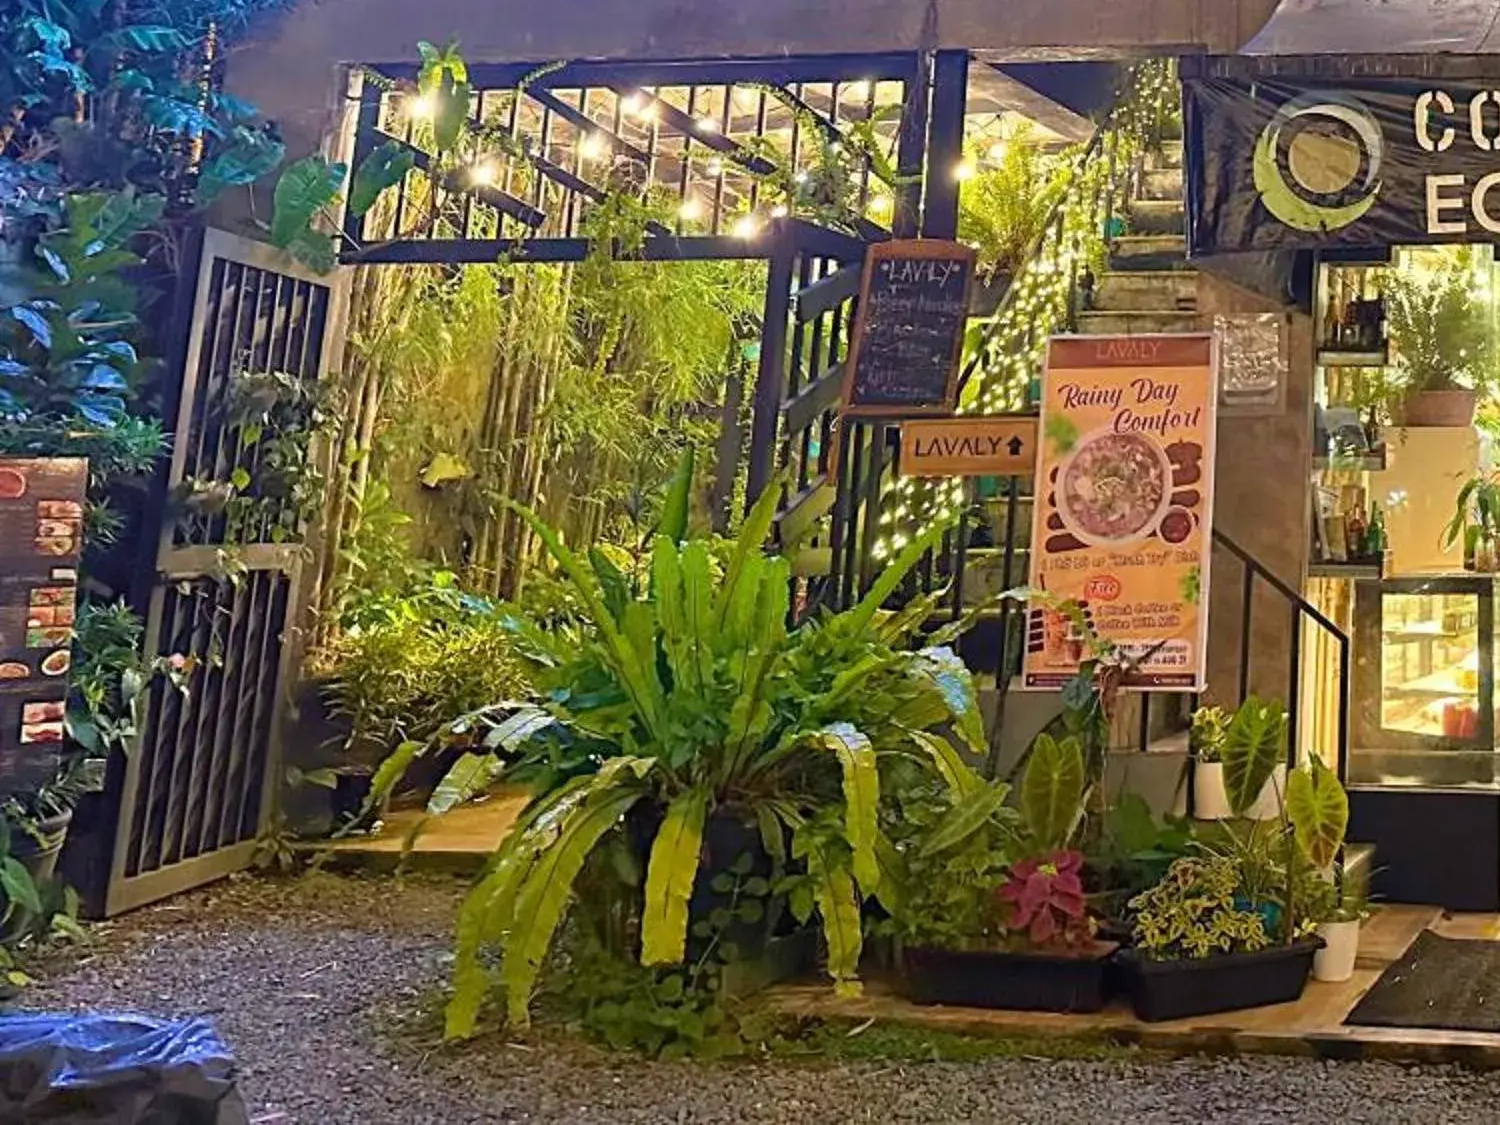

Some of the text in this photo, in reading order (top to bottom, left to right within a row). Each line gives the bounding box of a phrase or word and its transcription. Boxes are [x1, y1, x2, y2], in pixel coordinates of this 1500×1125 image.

[1057, 377, 1180, 411] Rainy Day
[1113, 407, 1202, 437] Comfort
[913, 436, 1002, 458] LAVALY
